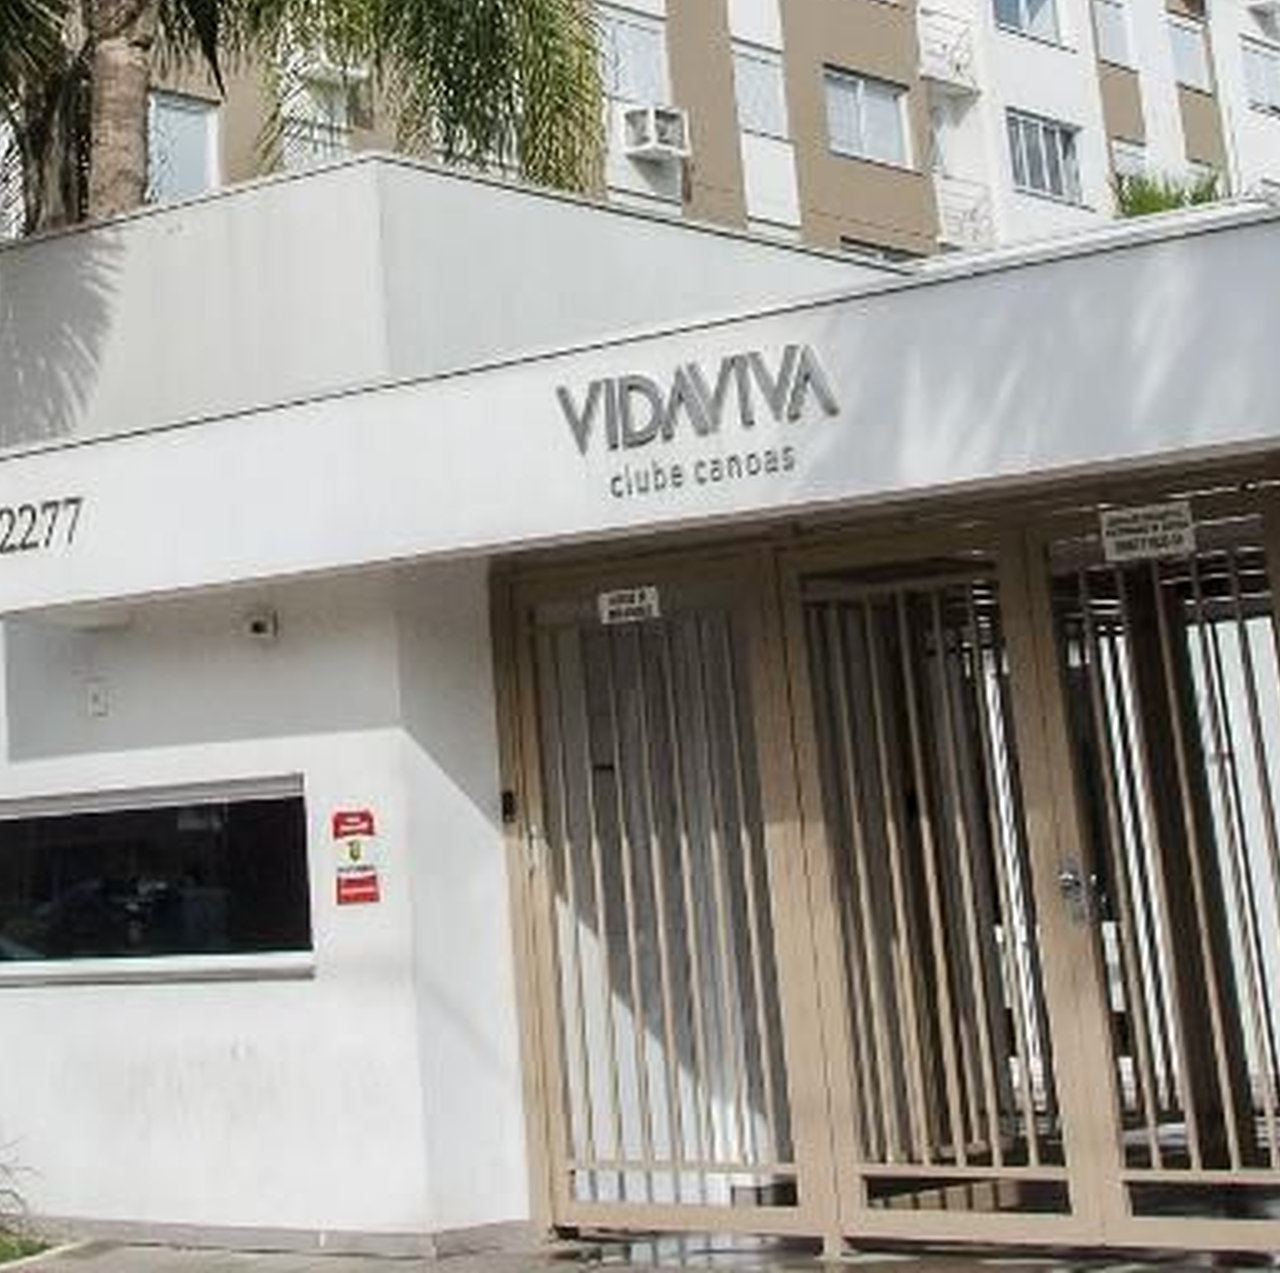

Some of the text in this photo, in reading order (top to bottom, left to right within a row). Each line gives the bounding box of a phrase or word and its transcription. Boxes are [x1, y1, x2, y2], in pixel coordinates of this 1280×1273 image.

[556, 344, 840, 455] VIDAVIVA
[610, 446, 796, 498] clube canoas
